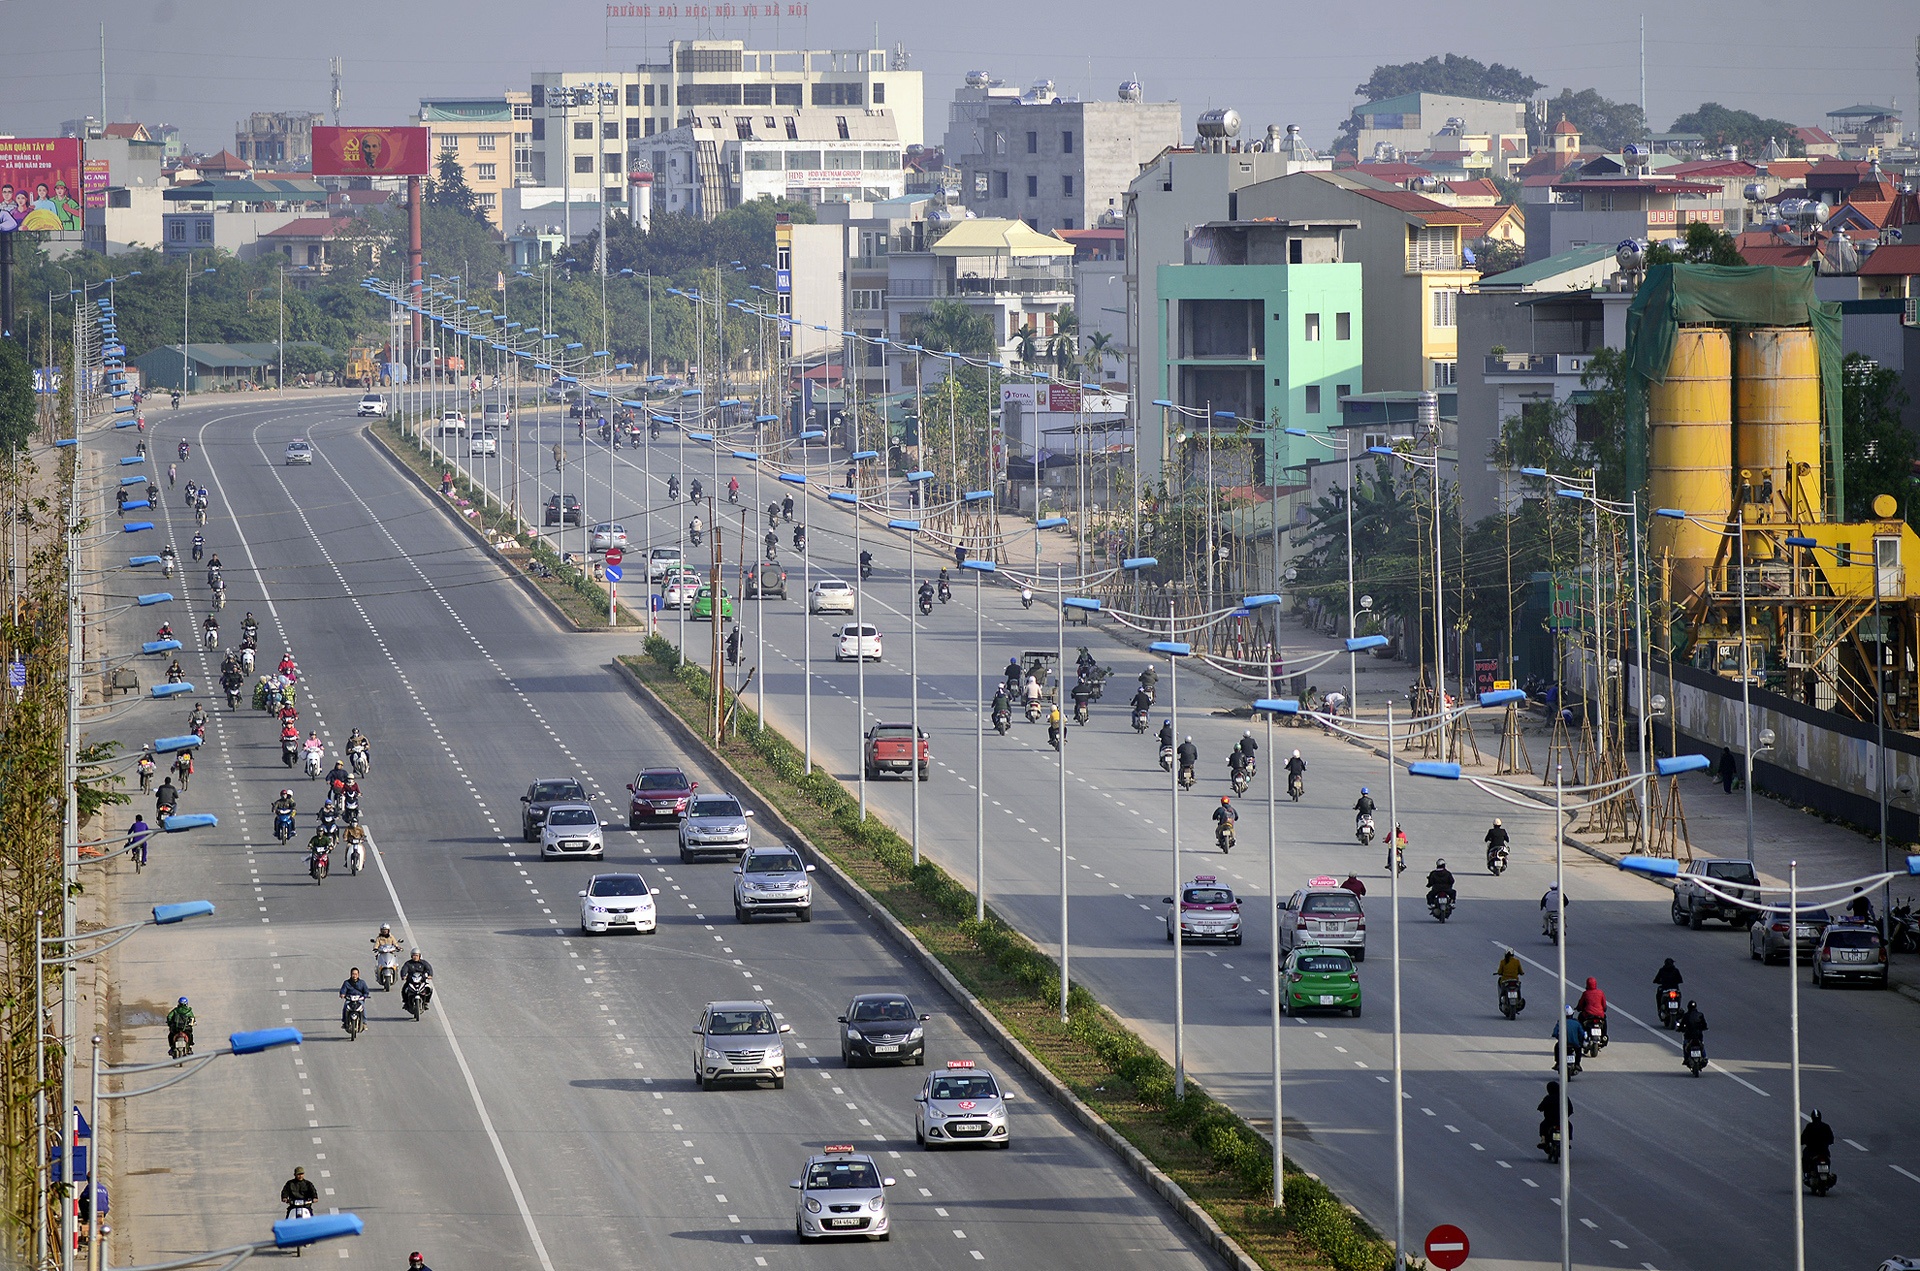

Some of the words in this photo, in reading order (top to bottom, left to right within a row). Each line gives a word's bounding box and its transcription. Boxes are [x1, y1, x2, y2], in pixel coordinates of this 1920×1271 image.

[606, 2, 651, 17] TRƯỜNG
[659, 5, 678, 20] ĐẠI
[685, 5, 708, 20] HỌC
[715, 3, 736, 19] NỘI
[742, 5, 758, 19] VỤ
[764, 2, 780, 17] HÀ
[787, 2, 808, 18] NỘI
[1720, 646, 1730, 655] 02
[1476, 660, 1497, 671] PHỞ
[1479, 673, 1494, 683] GÀ
